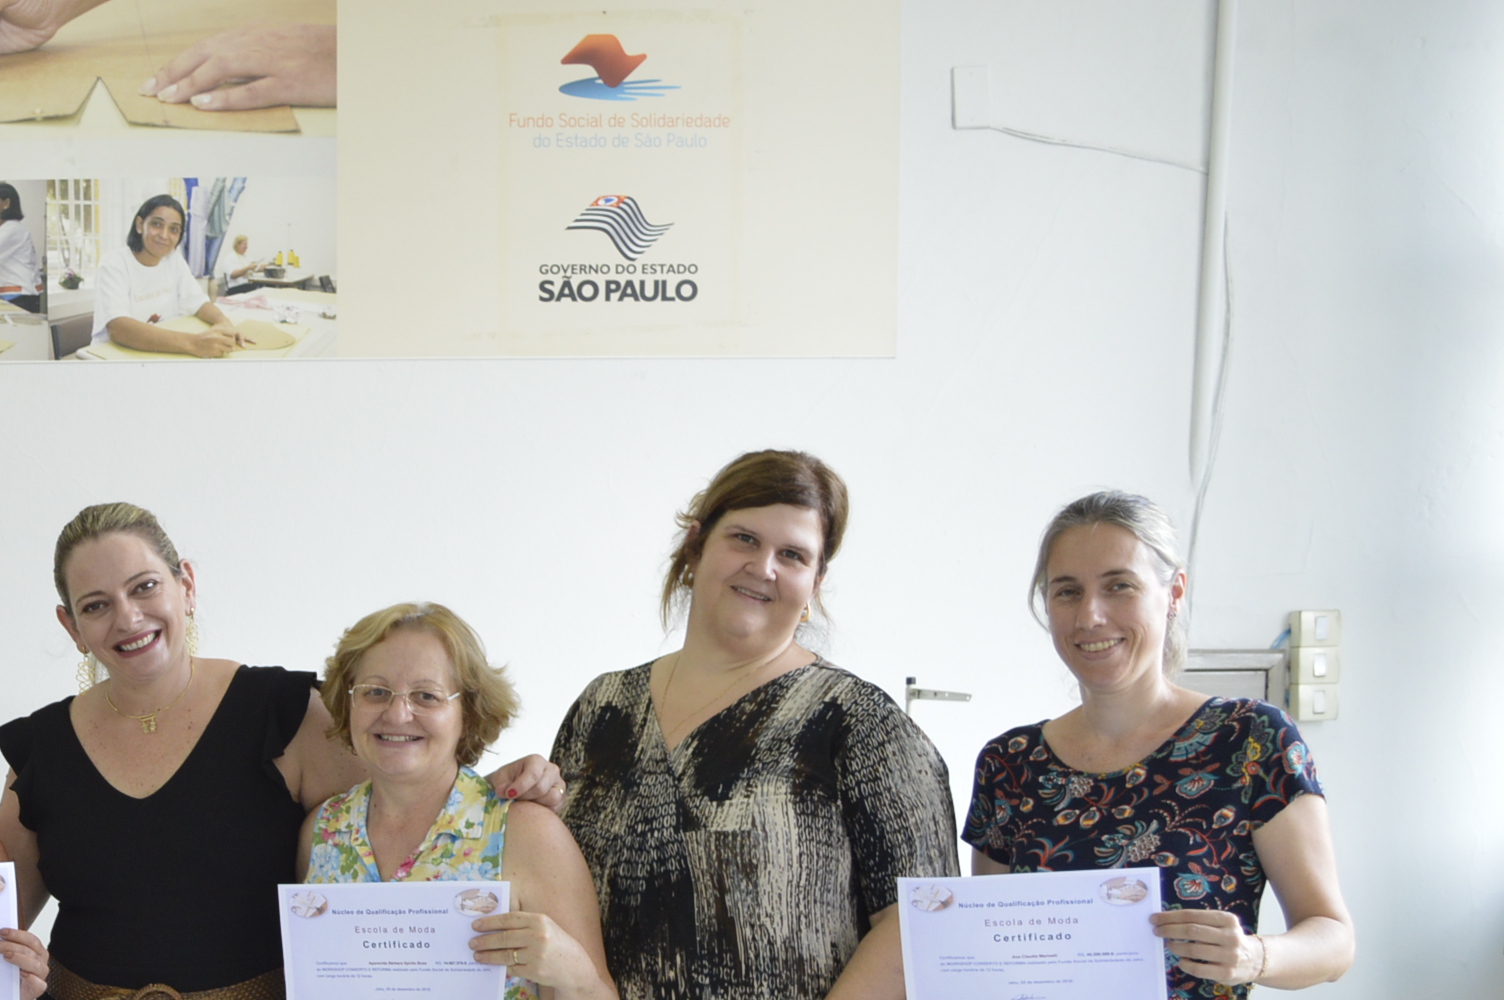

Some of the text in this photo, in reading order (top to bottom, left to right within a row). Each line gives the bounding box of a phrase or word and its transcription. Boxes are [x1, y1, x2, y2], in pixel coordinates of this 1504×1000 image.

[509, 113, 730, 129] Fundo Social de Solidariedade
[532, 133, 707, 149] do Estado de São Paulo
[539, 263, 698, 275] GOVERNO DO ESTADO
[538, 275, 698, 303] SÃO PAULO
[998, 900, 1045, 908] Qualificação
[1047, 898, 1093, 906] Profissional
[985, 916, 1079, 927] Escola de Moda
[355, 925, 436, 934] Escola de Moda
[993, 932, 1072, 943] Certificado
[363, 940, 430, 949] Certificado
